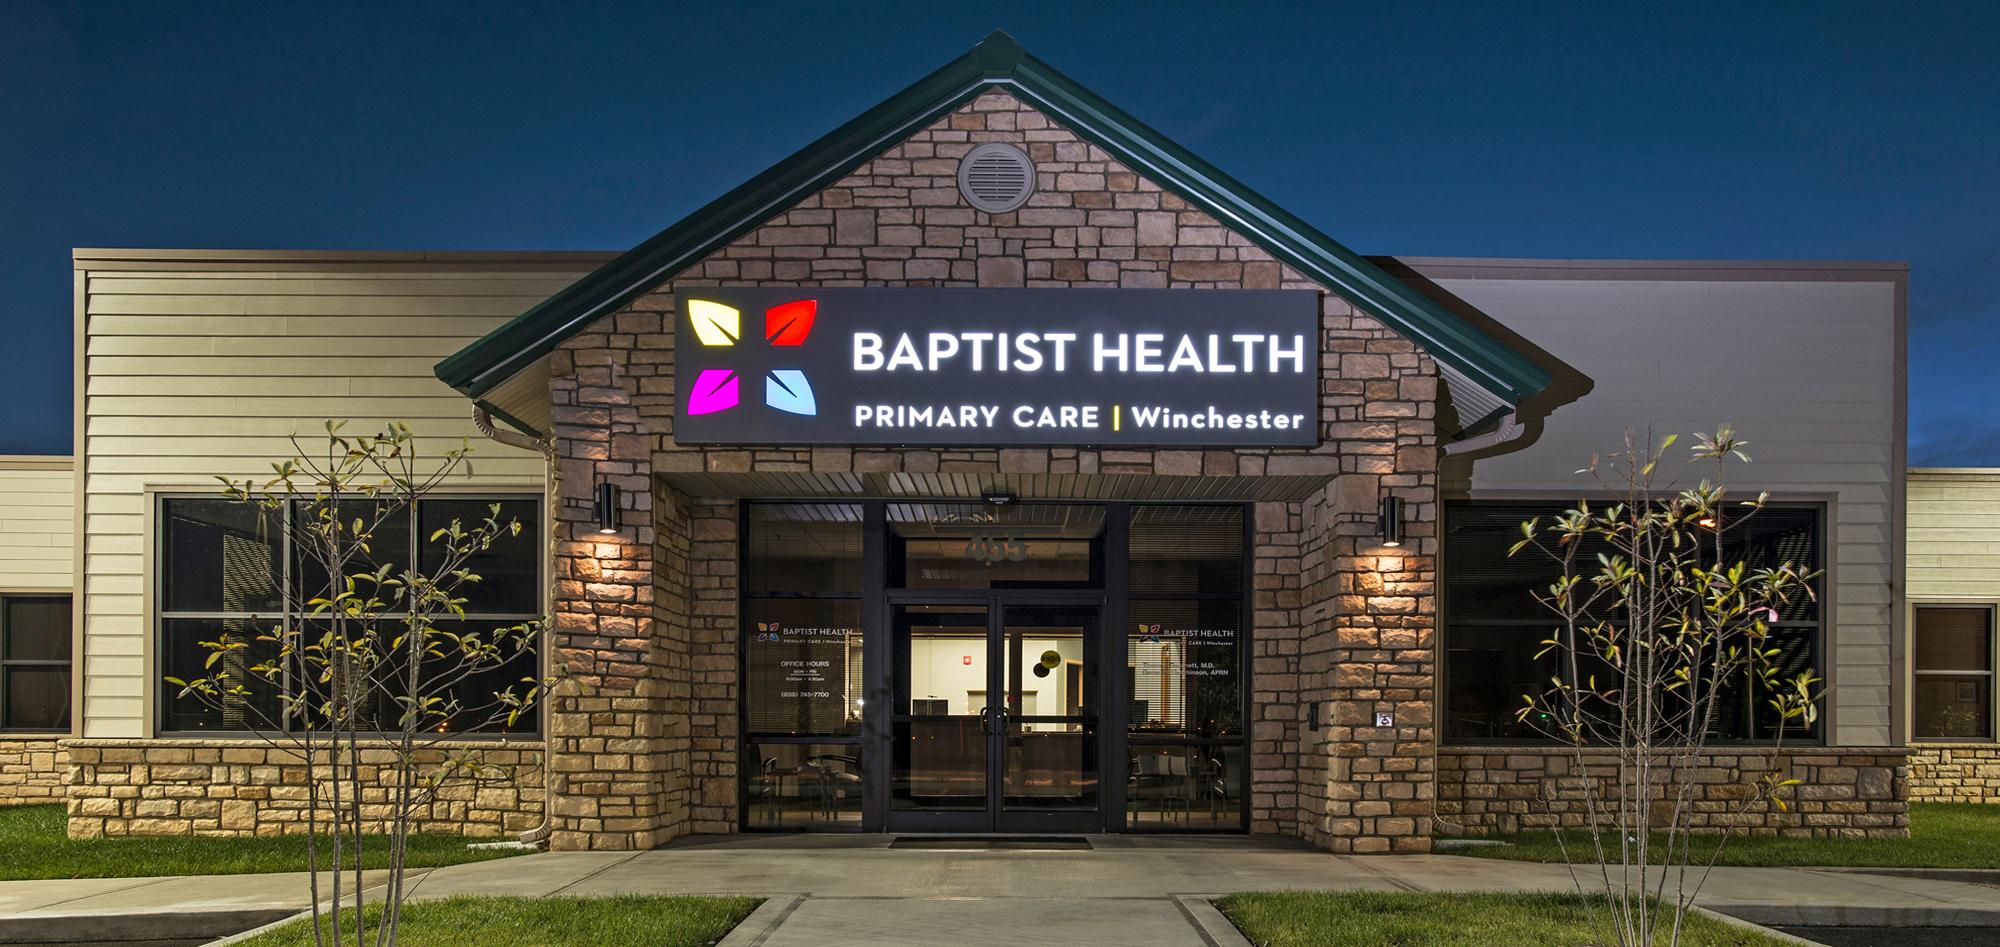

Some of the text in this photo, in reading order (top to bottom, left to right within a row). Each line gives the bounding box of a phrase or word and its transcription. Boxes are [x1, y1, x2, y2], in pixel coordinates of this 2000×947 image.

[853, 332, 1304, 373] BAPTIST HEALTH
[855, 405, 1304, 429] PRIMARY CARE Winchester
[965, 531, 1025, 562] 455
